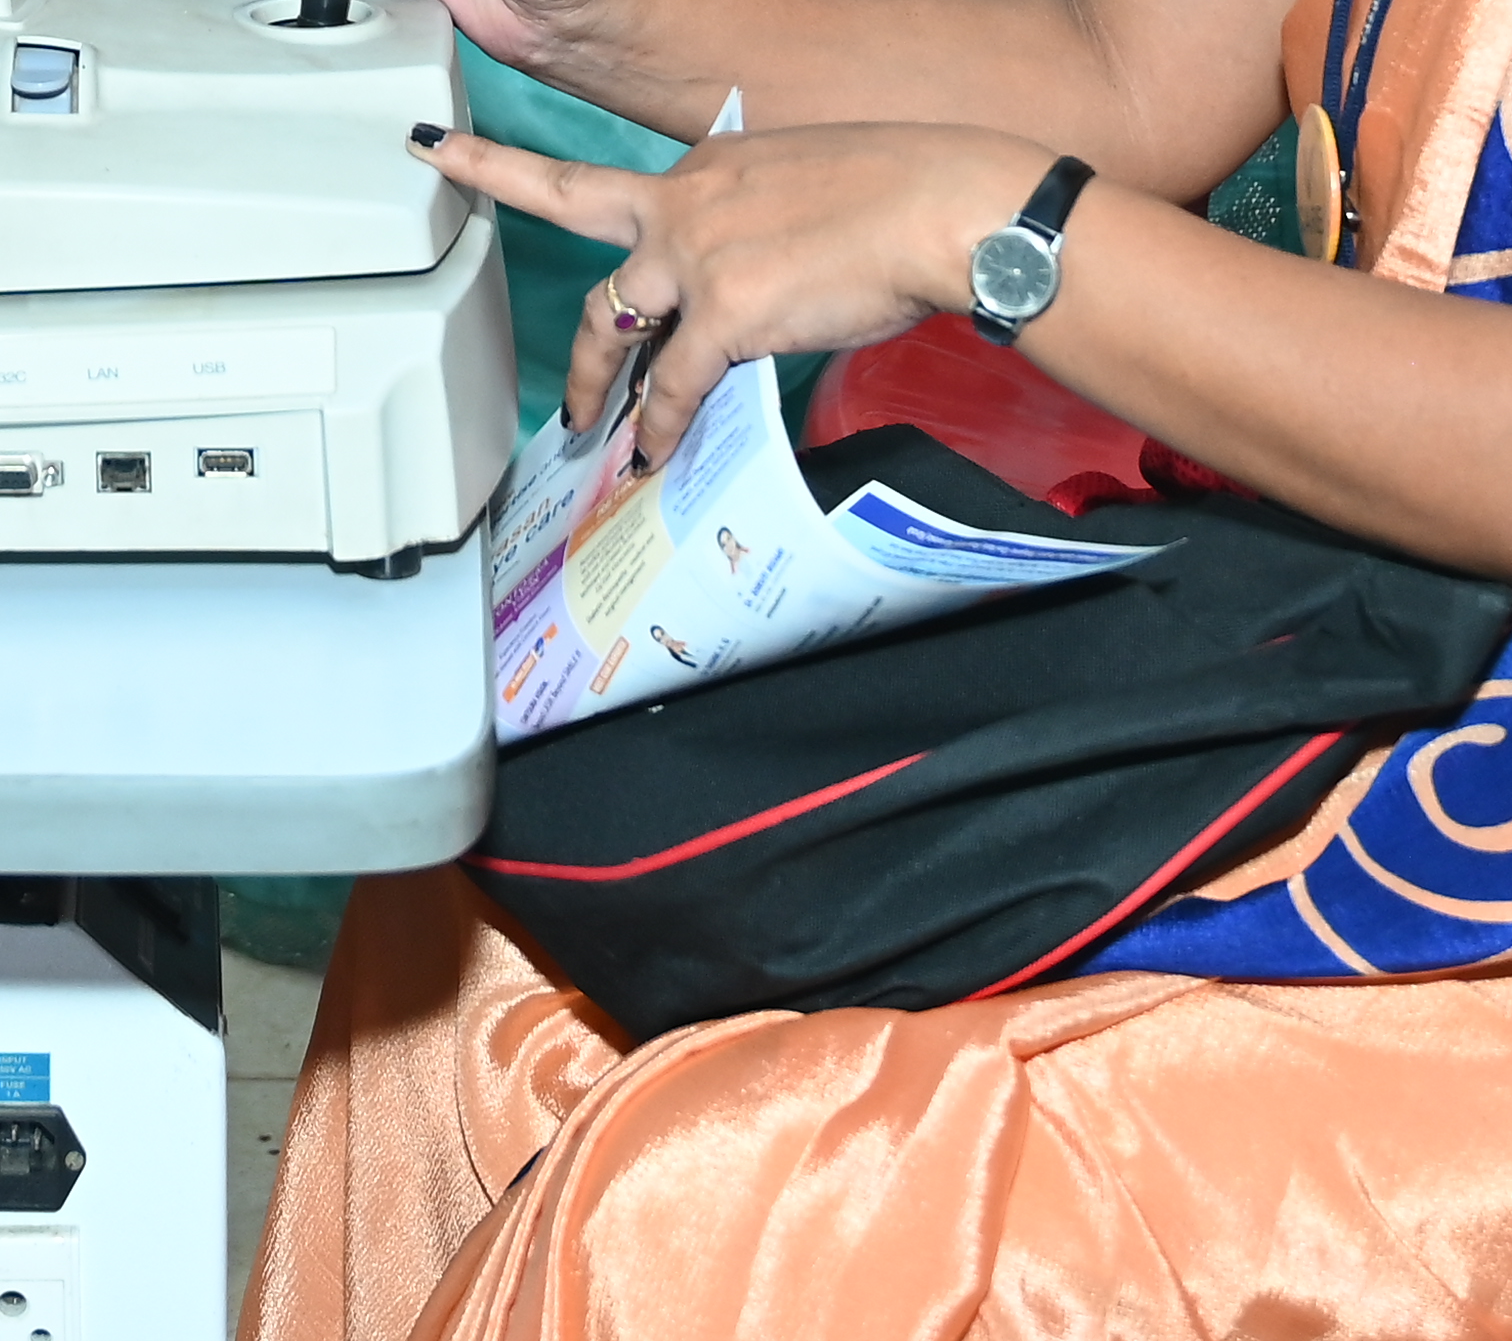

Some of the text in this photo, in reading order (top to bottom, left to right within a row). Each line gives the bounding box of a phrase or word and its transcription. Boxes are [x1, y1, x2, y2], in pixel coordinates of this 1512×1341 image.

[87, 367, 119, 380] LAN
[192, 361, 226, 375] USB
[523, 490, 578, 545] care
[0, 1080, 26, 1089] FUSE
[13, 1090, 21, 1098] A
